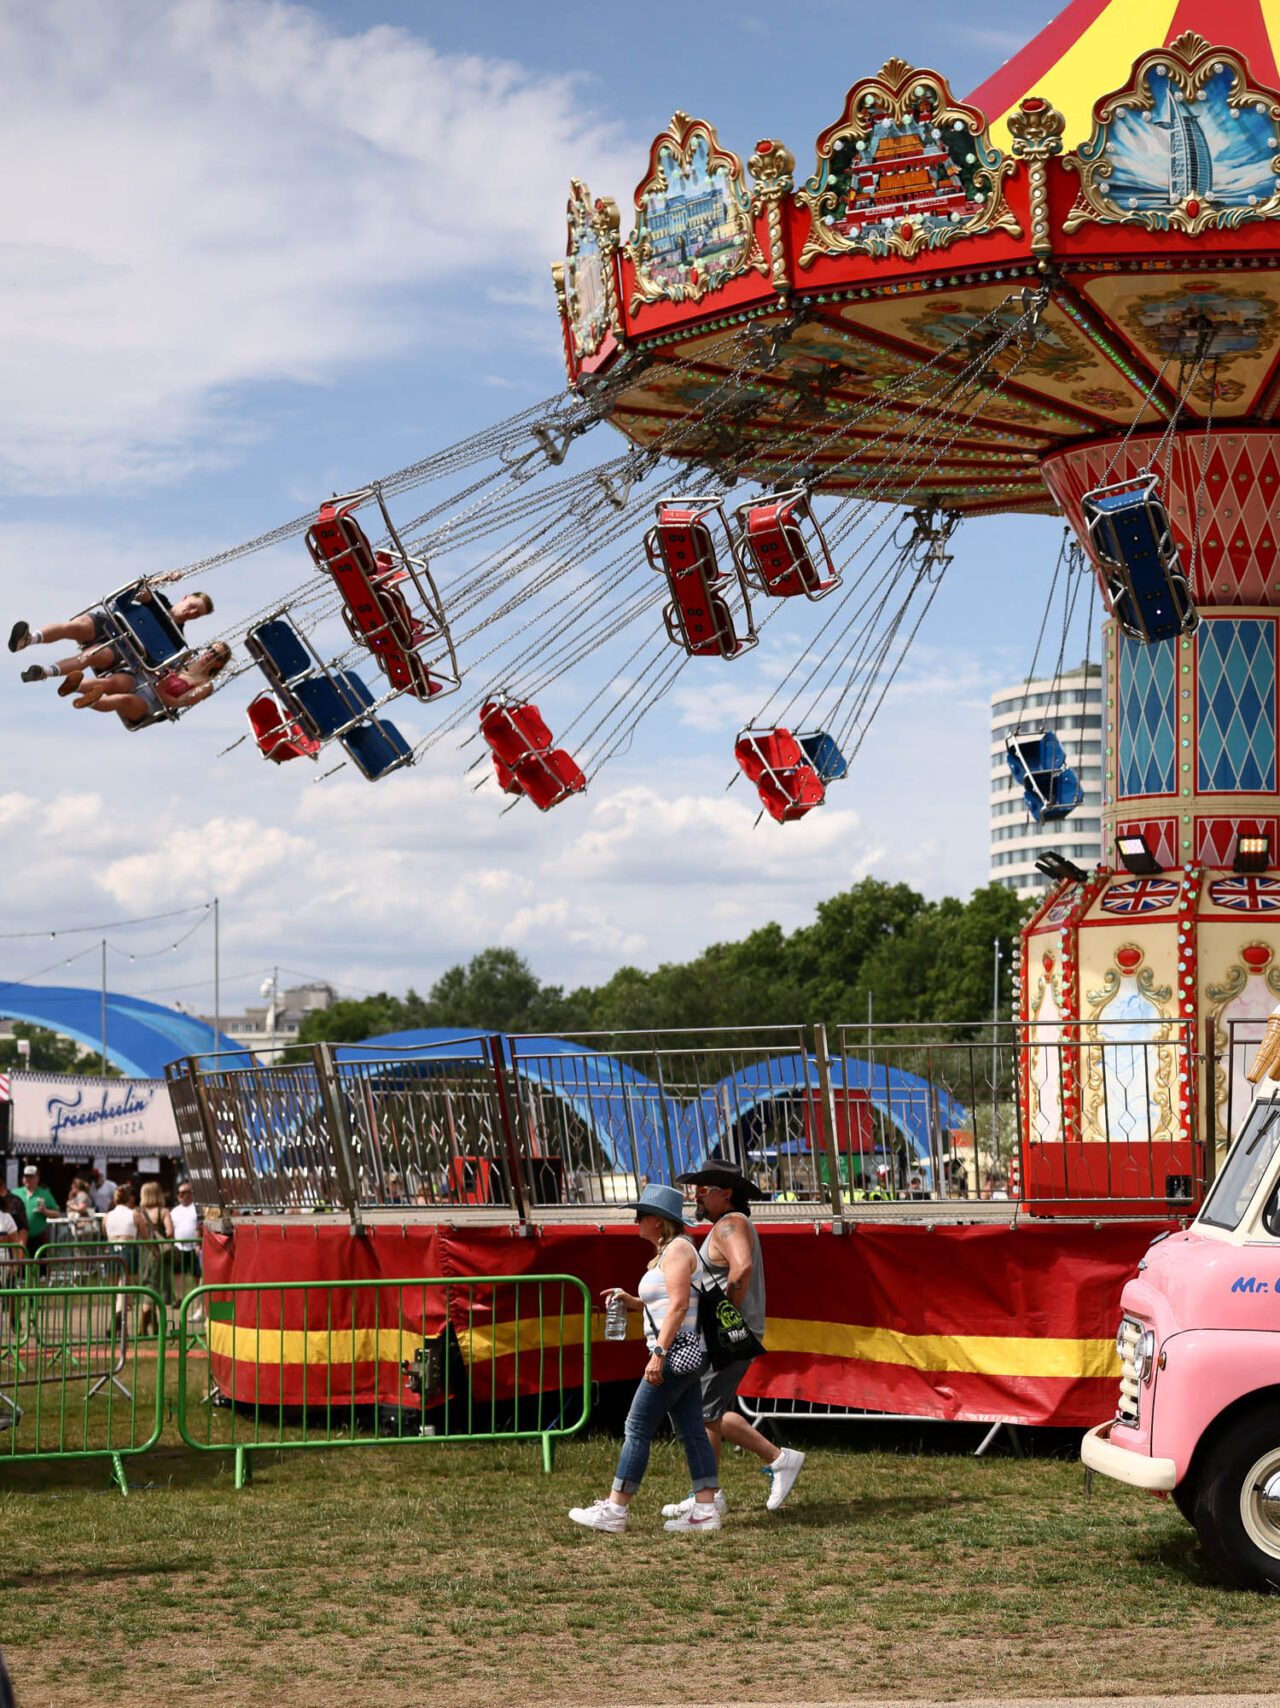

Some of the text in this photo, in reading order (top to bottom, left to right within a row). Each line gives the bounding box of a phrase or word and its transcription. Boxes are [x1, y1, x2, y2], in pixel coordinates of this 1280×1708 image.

[48, 1084, 154, 1146] Freewheelin'
[113, 1120, 144, 1136] PIZZA
[1231, 1276, 1268, 1293] Mr.
